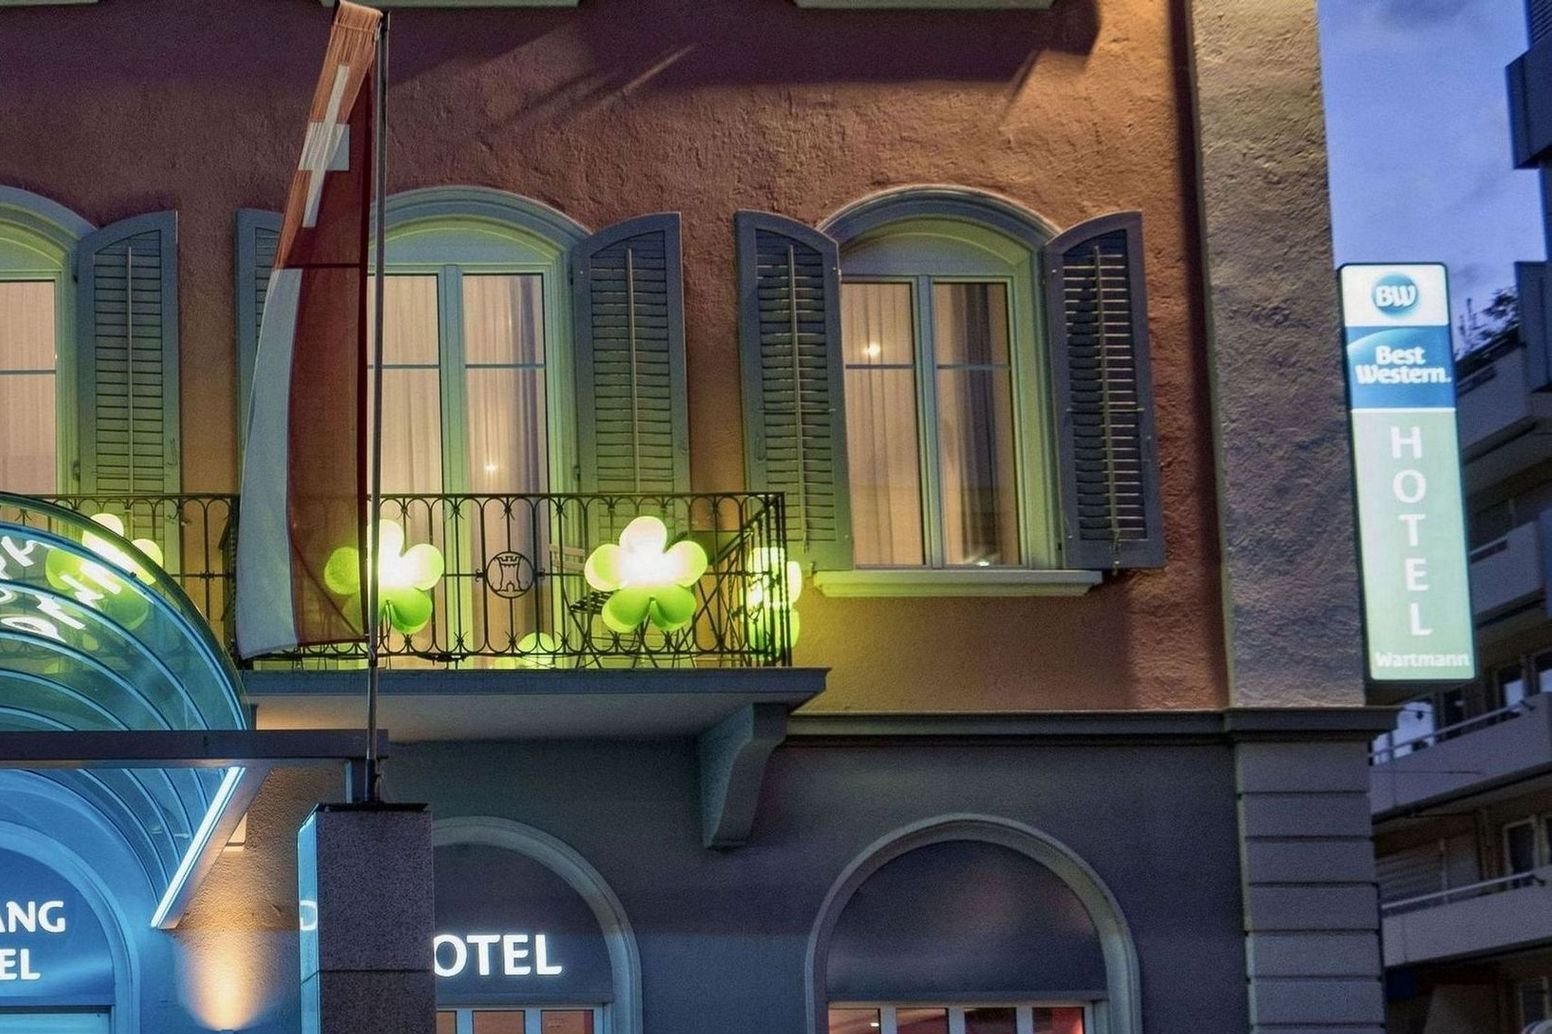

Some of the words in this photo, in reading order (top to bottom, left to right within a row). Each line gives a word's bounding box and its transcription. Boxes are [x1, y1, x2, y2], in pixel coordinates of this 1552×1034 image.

[1376, 285, 1417, 307] BW
[1376, 345, 1426, 365] Best
[1389, 426, 1433, 637] HOTEL
[1375, 652, 1470, 667] Wartmann
[433, 934, 563, 977] OTEL
